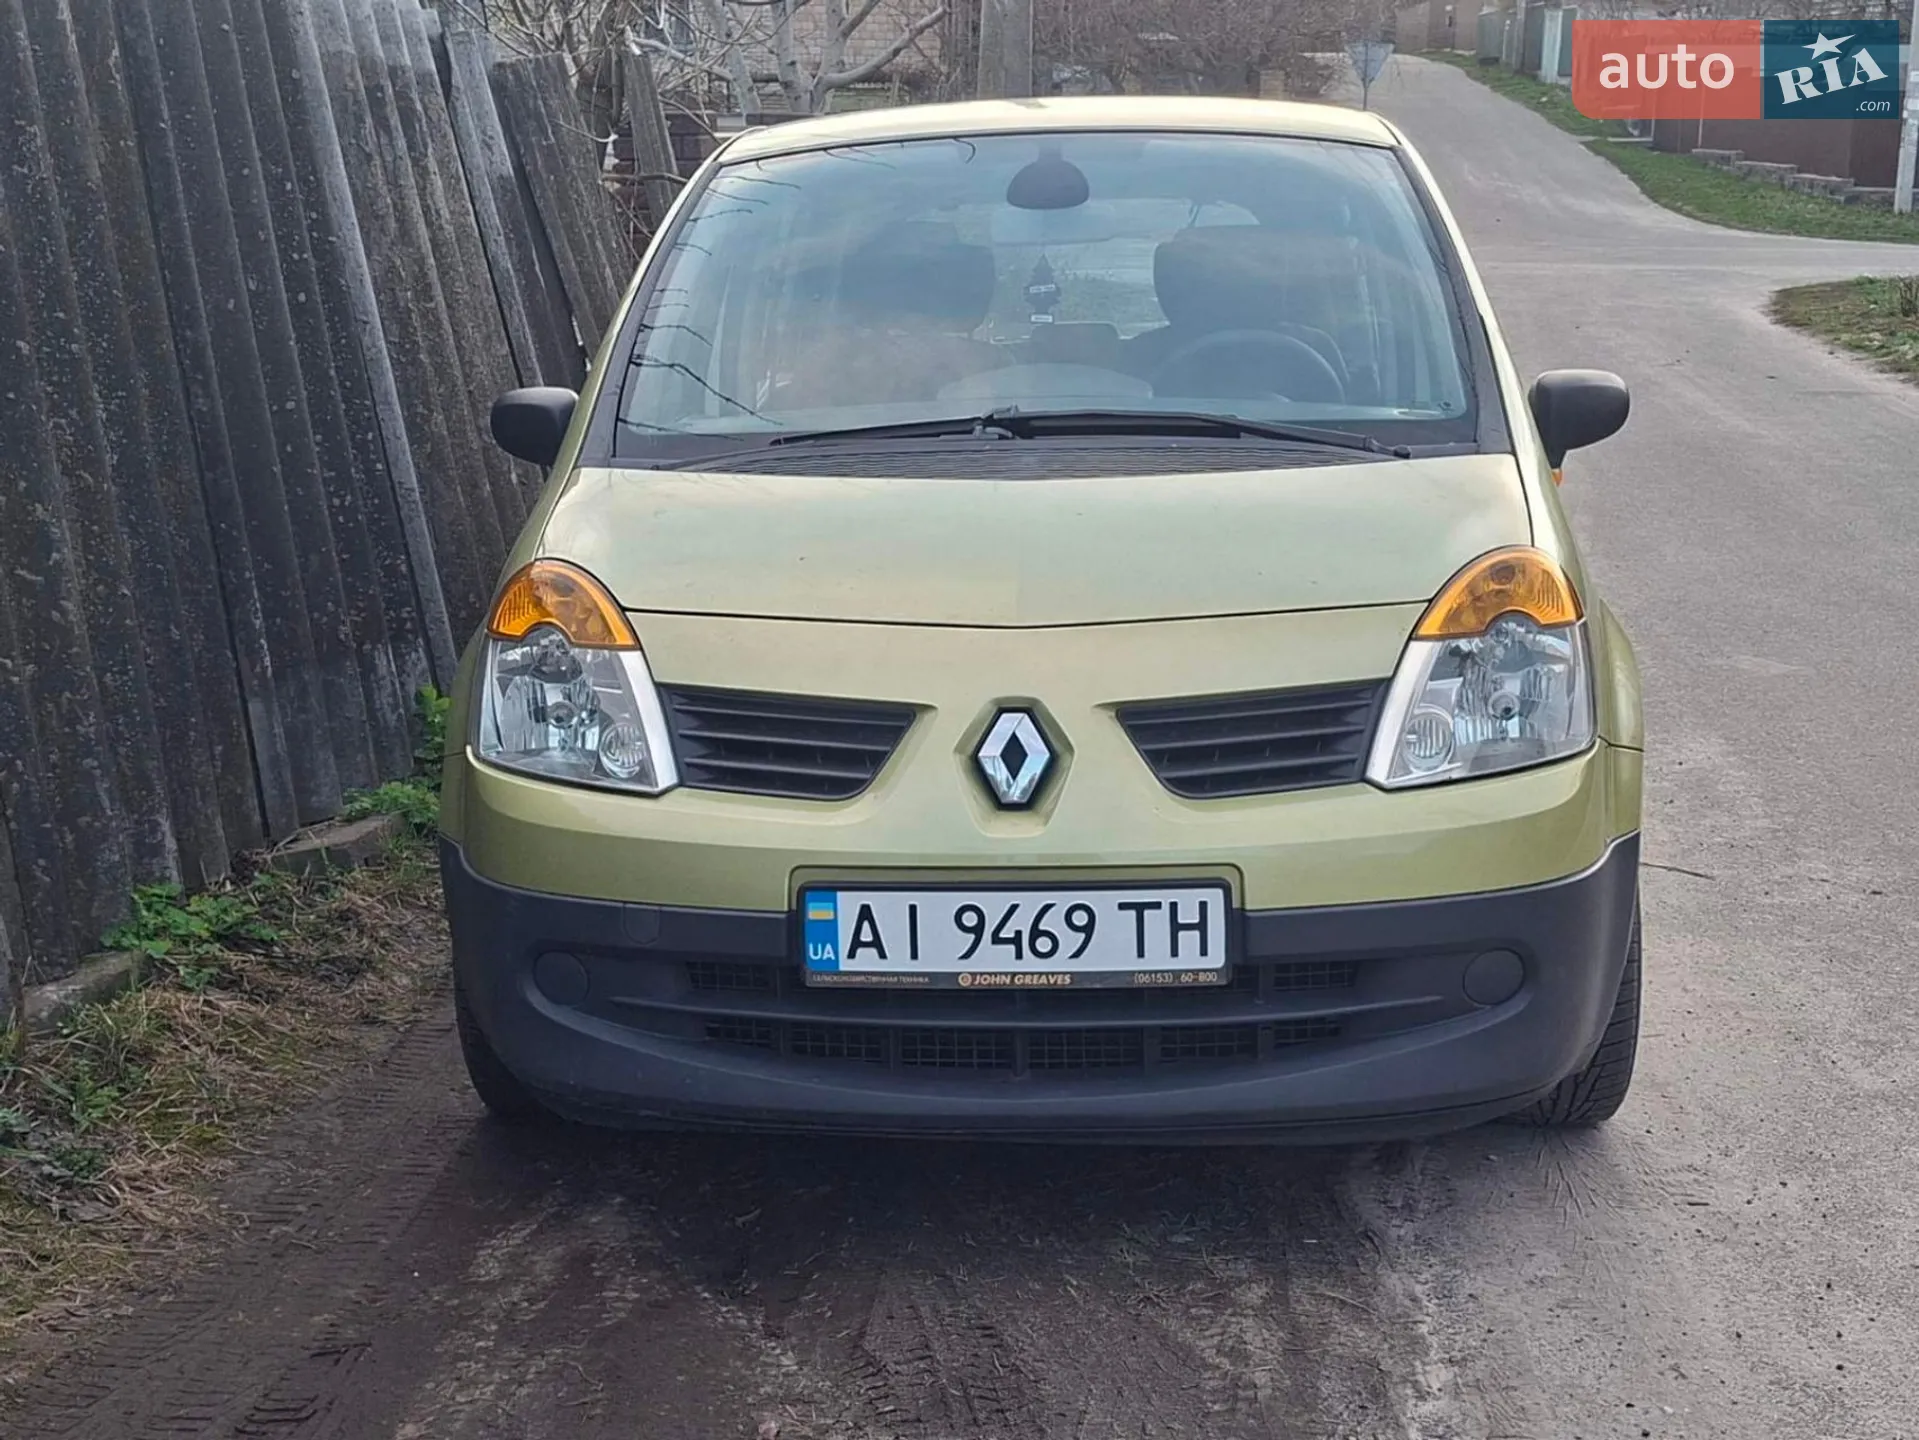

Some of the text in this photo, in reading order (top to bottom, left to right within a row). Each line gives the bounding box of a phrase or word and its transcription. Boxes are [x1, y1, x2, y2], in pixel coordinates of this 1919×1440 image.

[953, 902, 1097, 960] 9469
[1117, 899, 1209, 959] TH
[808, 942, 836, 961] UA
[973, 973, 1072, 985] JOHN GREAVES
[1134, 972, 1173, 984] (06153)
